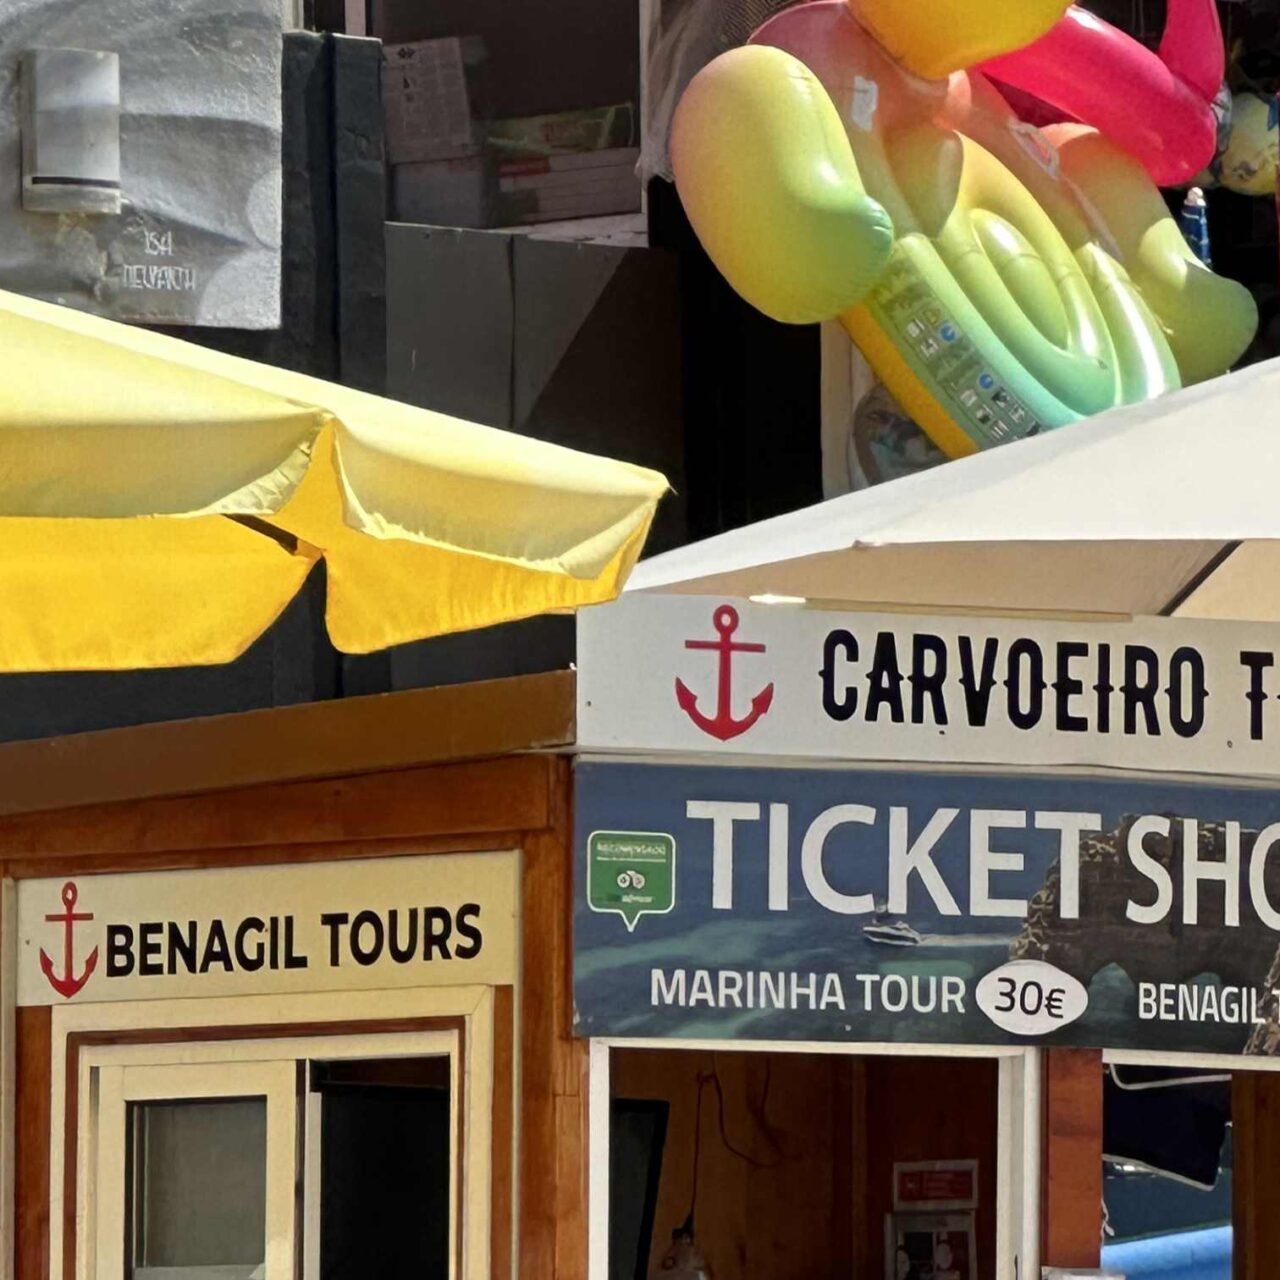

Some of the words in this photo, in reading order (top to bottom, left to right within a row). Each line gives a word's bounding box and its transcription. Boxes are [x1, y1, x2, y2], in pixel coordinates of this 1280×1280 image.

[819, 630, 1208, 737] CARVOEIRO
[686, 801, 1101, 918] TICKET
[106, 916, 308, 976] BENAGIL
[321, 904, 482, 967] TOURS
[651, 970, 846, 1010] MARINHA
[857, 976, 966, 1013] TOUR
[994, 977, 1065, 1019] 30€
[1140, 983, 1265, 1025] BENAGIL
